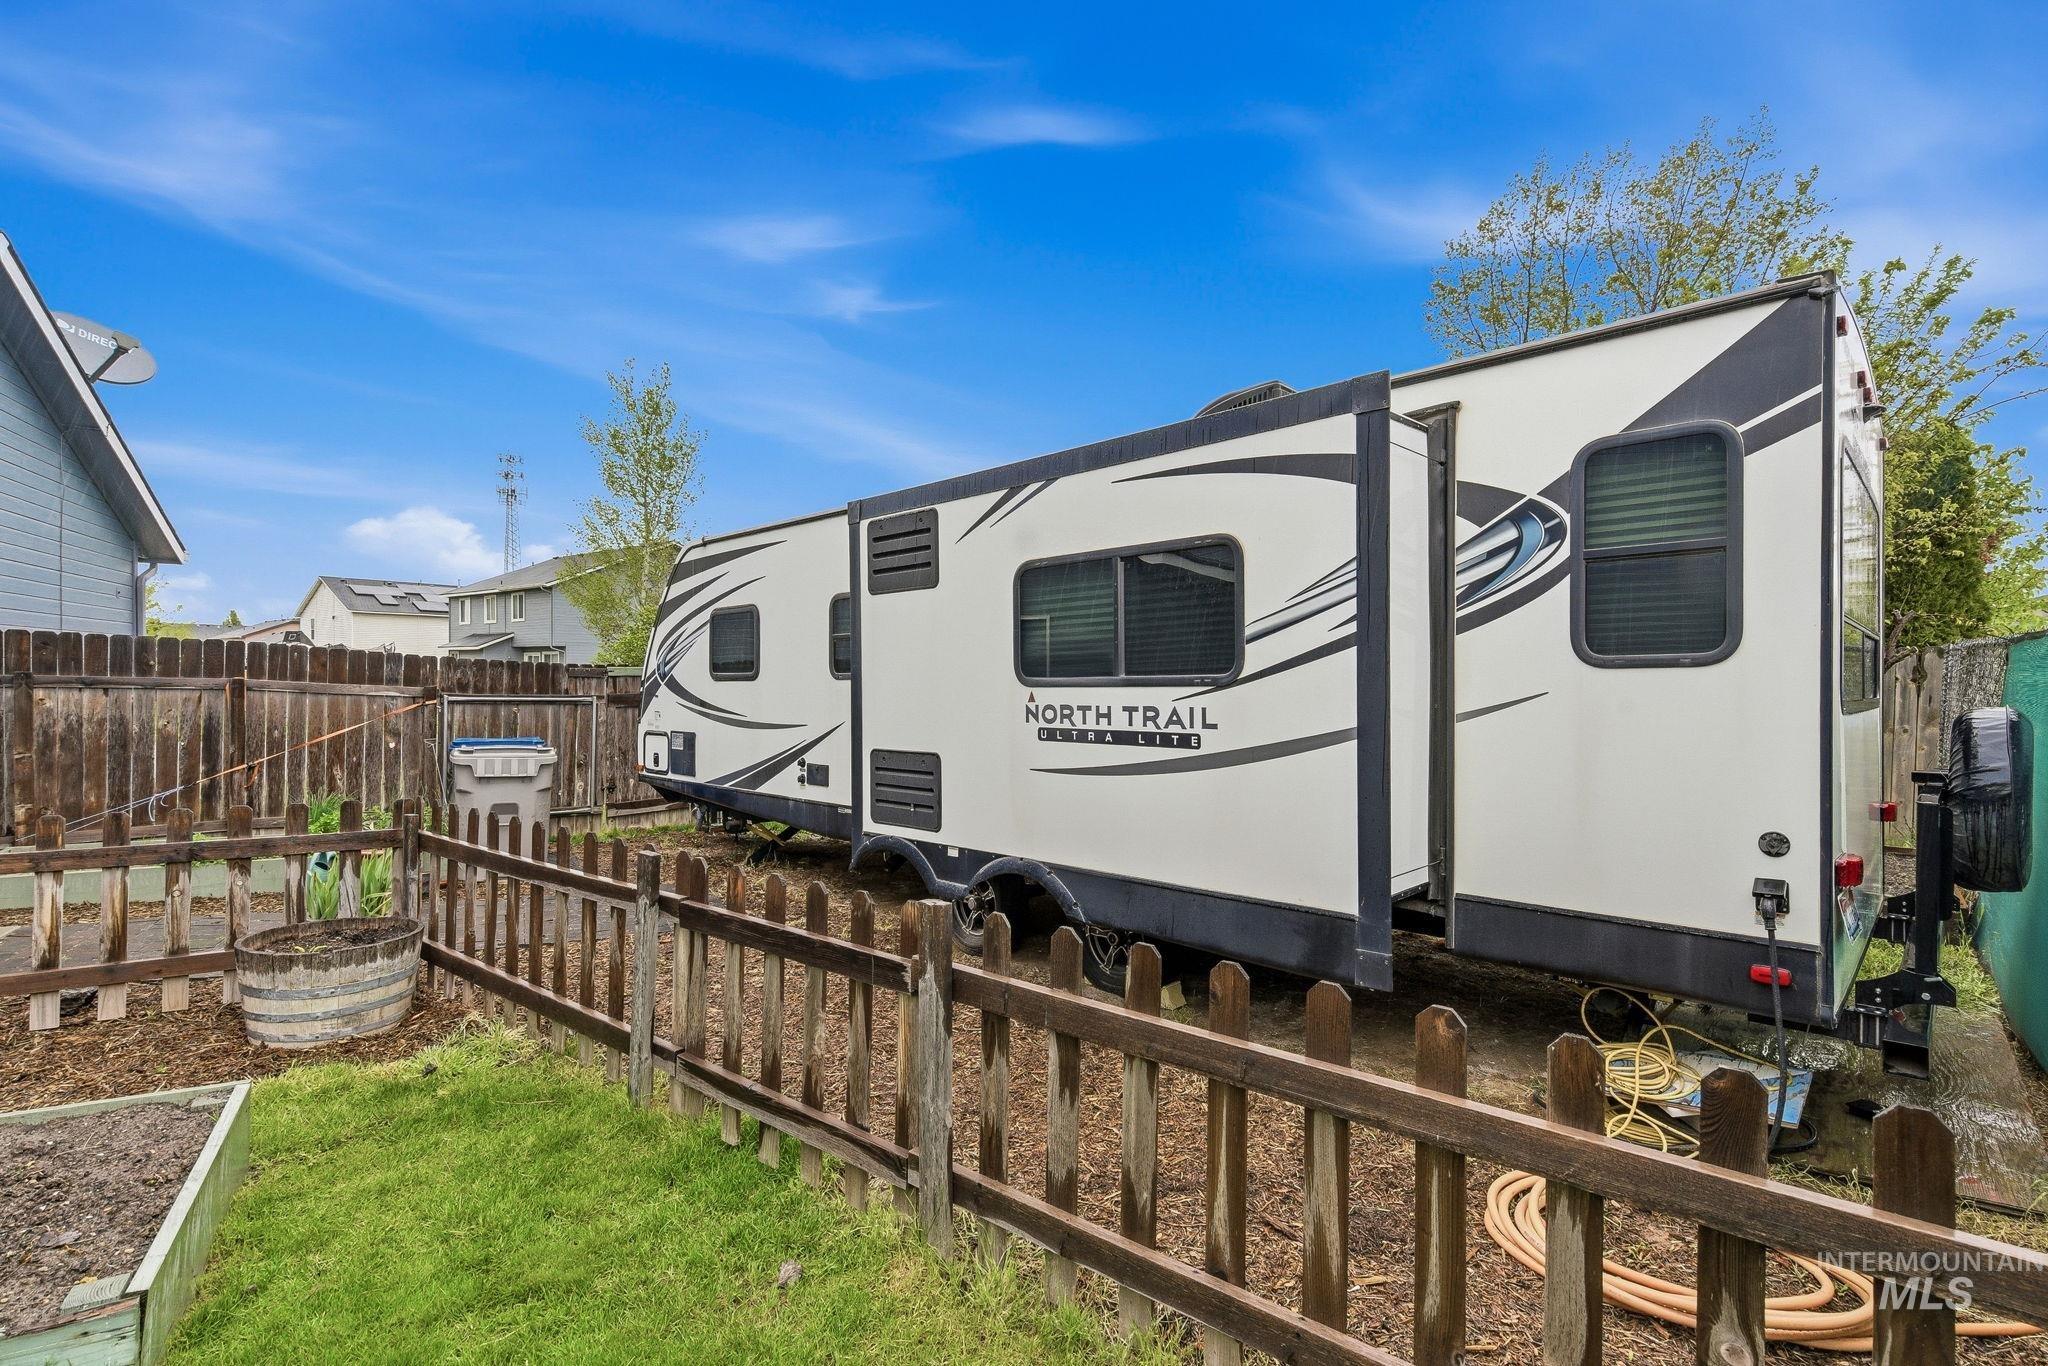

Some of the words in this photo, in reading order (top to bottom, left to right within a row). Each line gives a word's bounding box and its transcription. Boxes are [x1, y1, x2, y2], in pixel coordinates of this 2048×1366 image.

[78, 328, 118, 349] DIREC
[1026, 704, 1112, 727] NORTH
[1122, 706, 1218, 730] TRAIL
[1040, 730, 1113, 742] ULTRA
[1138, 734, 1199, 747] LITE
